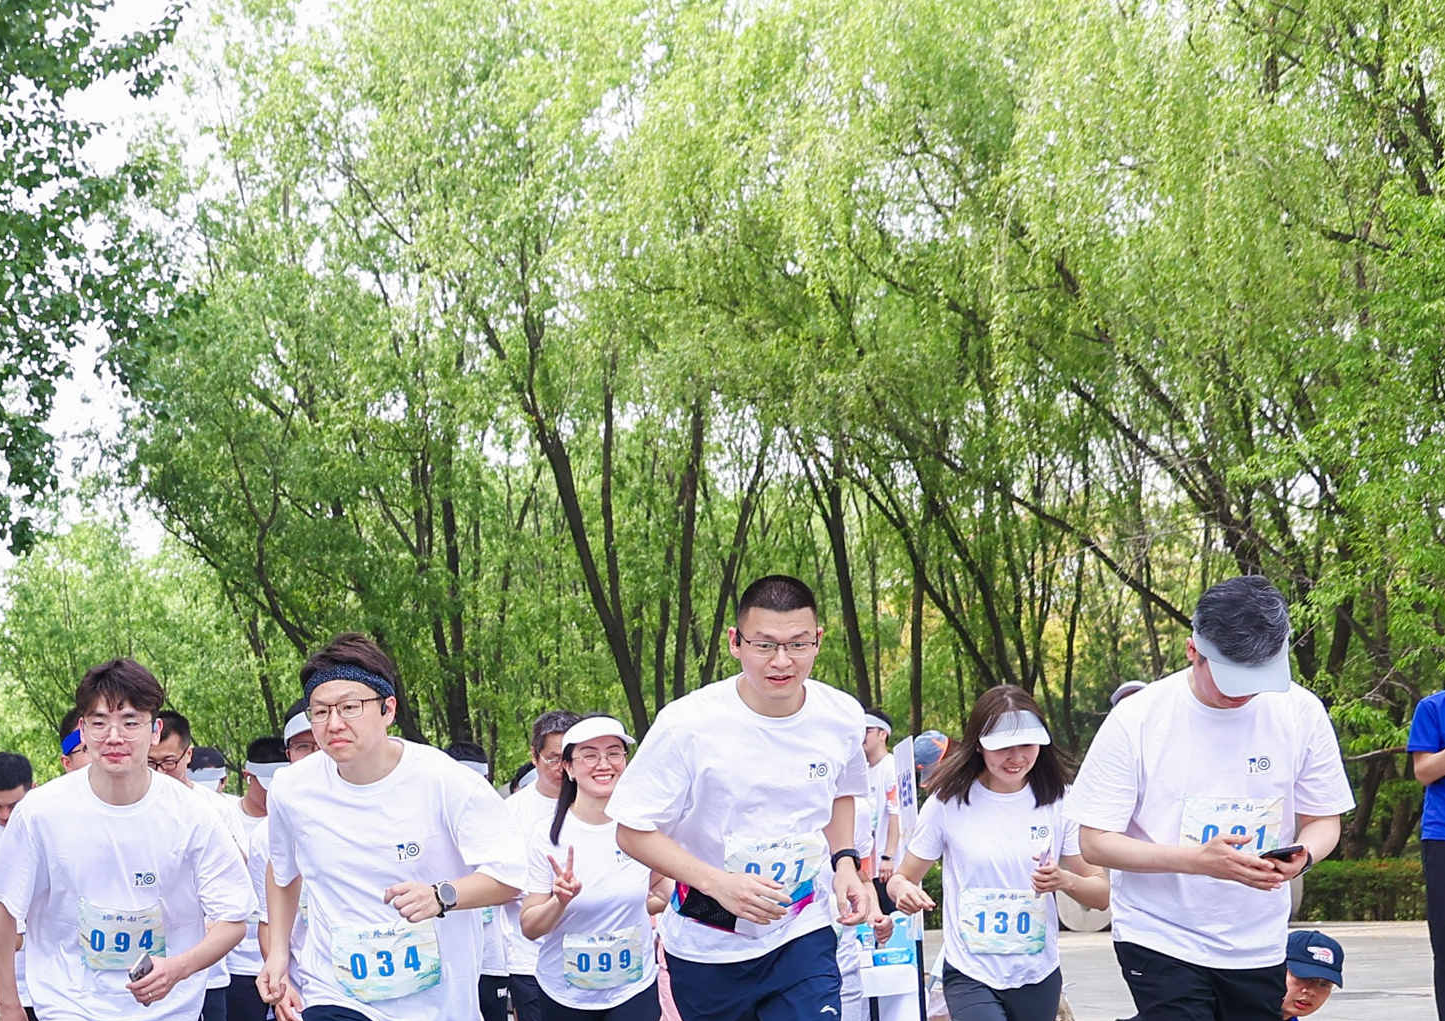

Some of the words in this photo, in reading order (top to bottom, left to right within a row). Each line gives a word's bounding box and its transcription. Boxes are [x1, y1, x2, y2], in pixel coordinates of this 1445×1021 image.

[975, 911, 1031, 935] 130
[90, 928, 154, 953] 094
[350, 945, 421, 980] 034
[576, 948, 632, 973] 099
